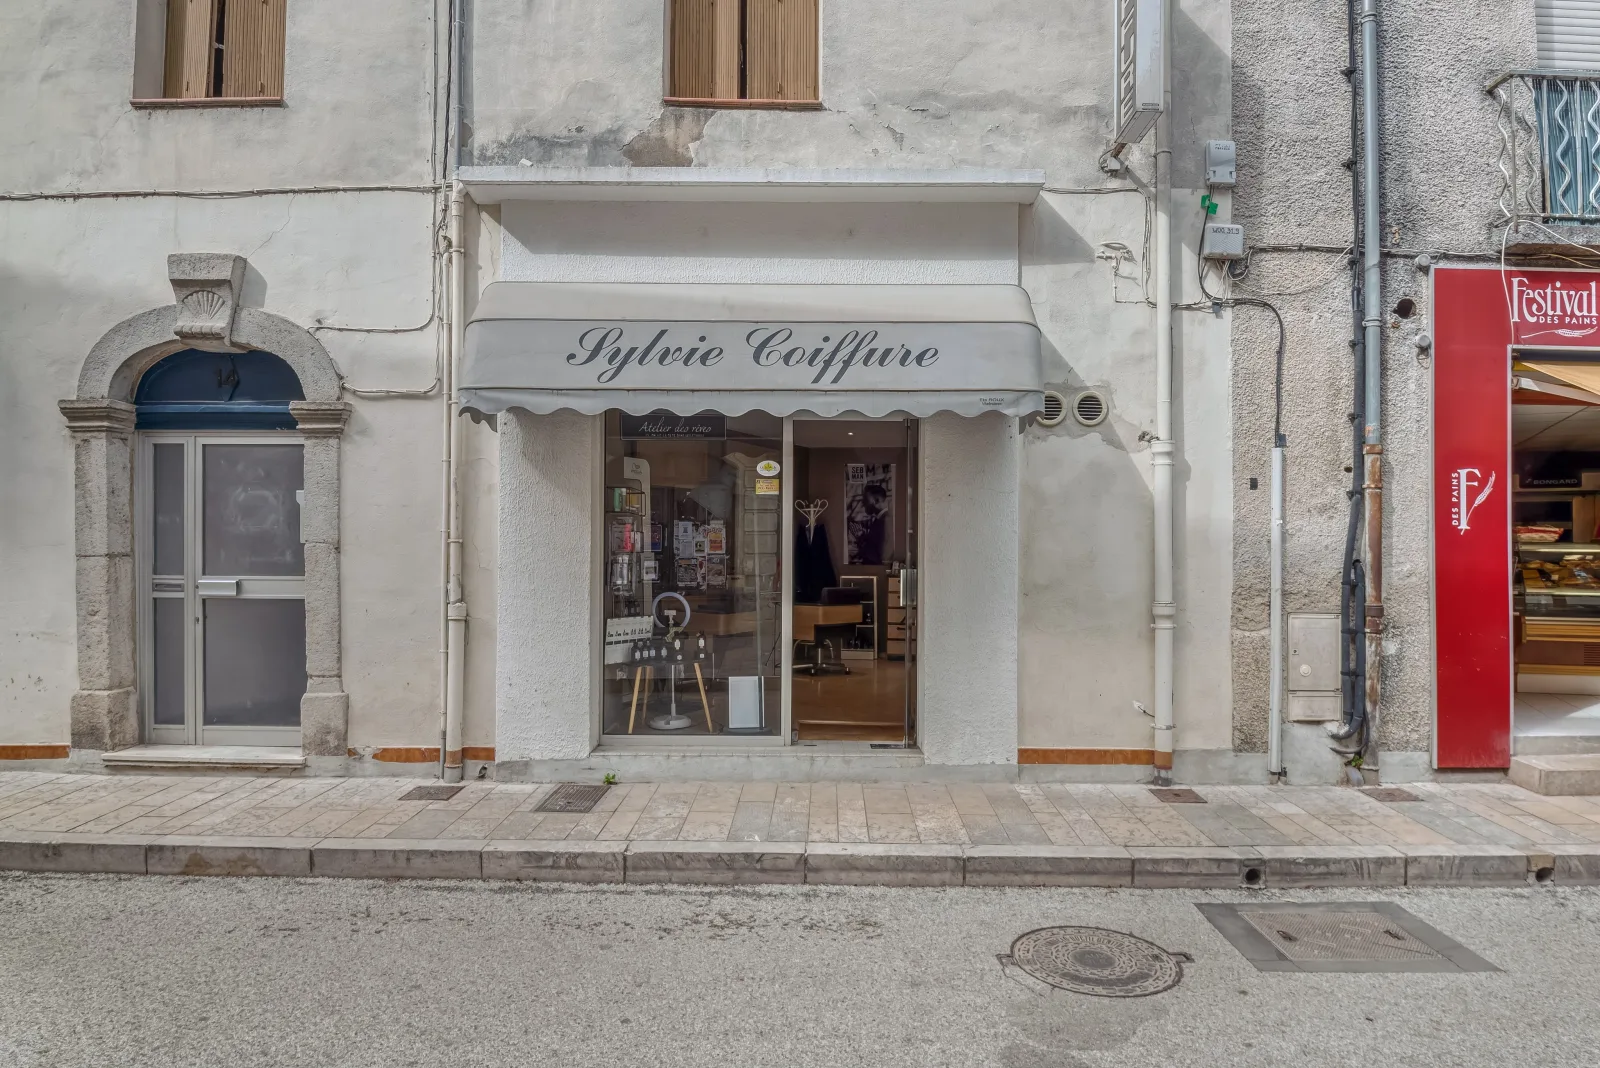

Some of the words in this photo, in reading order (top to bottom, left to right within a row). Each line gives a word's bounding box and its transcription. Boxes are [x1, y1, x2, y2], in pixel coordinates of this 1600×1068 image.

[1511, 277, 1599, 323] Festival
[1539, 316, 1559, 324] DES
[1565, 316, 1597, 325] PAINS
[566, 326, 725, 384] Sylvie
[745, 326, 941, 385] Coiffure
[638, 416, 672, 433] Atelier
[674, 417, 689, 433] des
[1451, 472, 1459, 502] PAINS
[1451, 507, 1459, 526] DES
